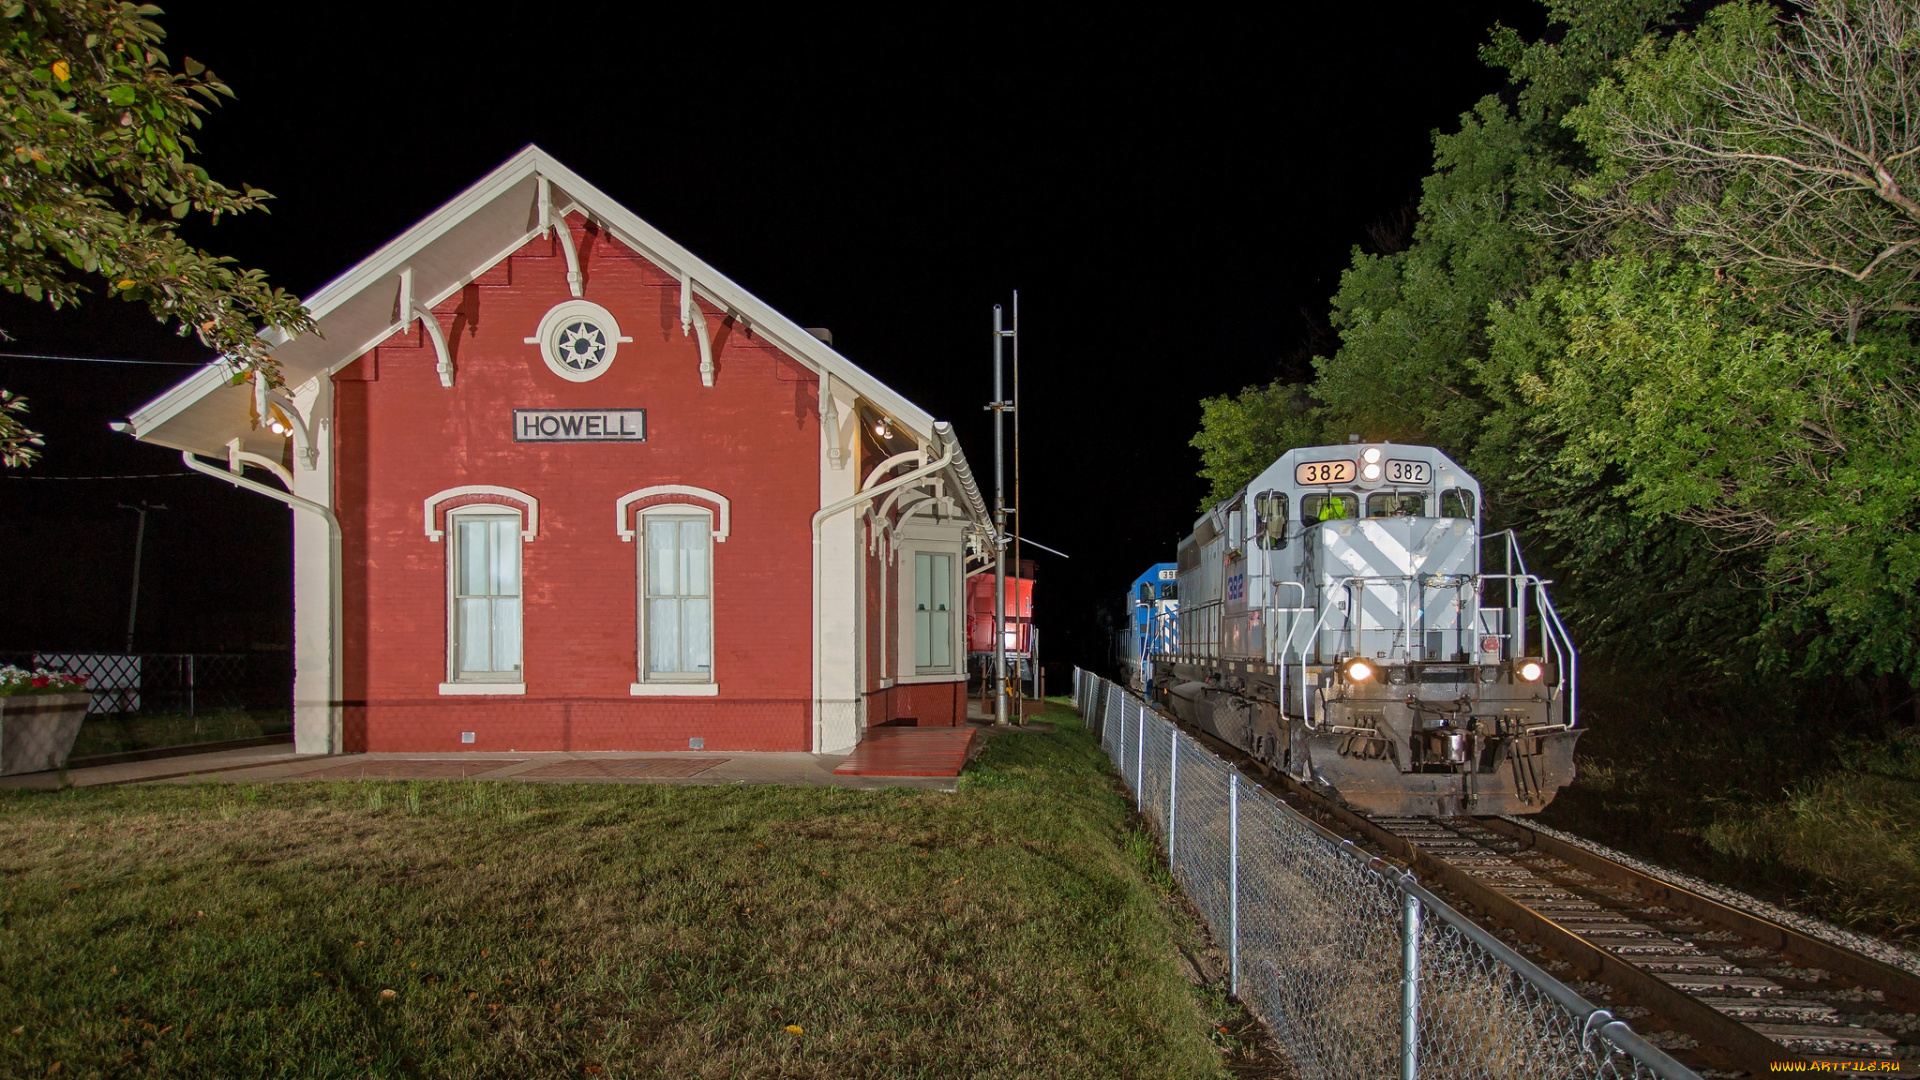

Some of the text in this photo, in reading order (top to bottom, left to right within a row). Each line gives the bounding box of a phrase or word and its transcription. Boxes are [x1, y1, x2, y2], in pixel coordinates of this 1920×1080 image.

[523, 415, 636, 436] HOWELL
[1306, 463, 1345, 482] 382
[1393, 463, 1423, 481] 382
[1163, 571, 1177, 579] 39
[1228, 573, 1243, 600] 382
